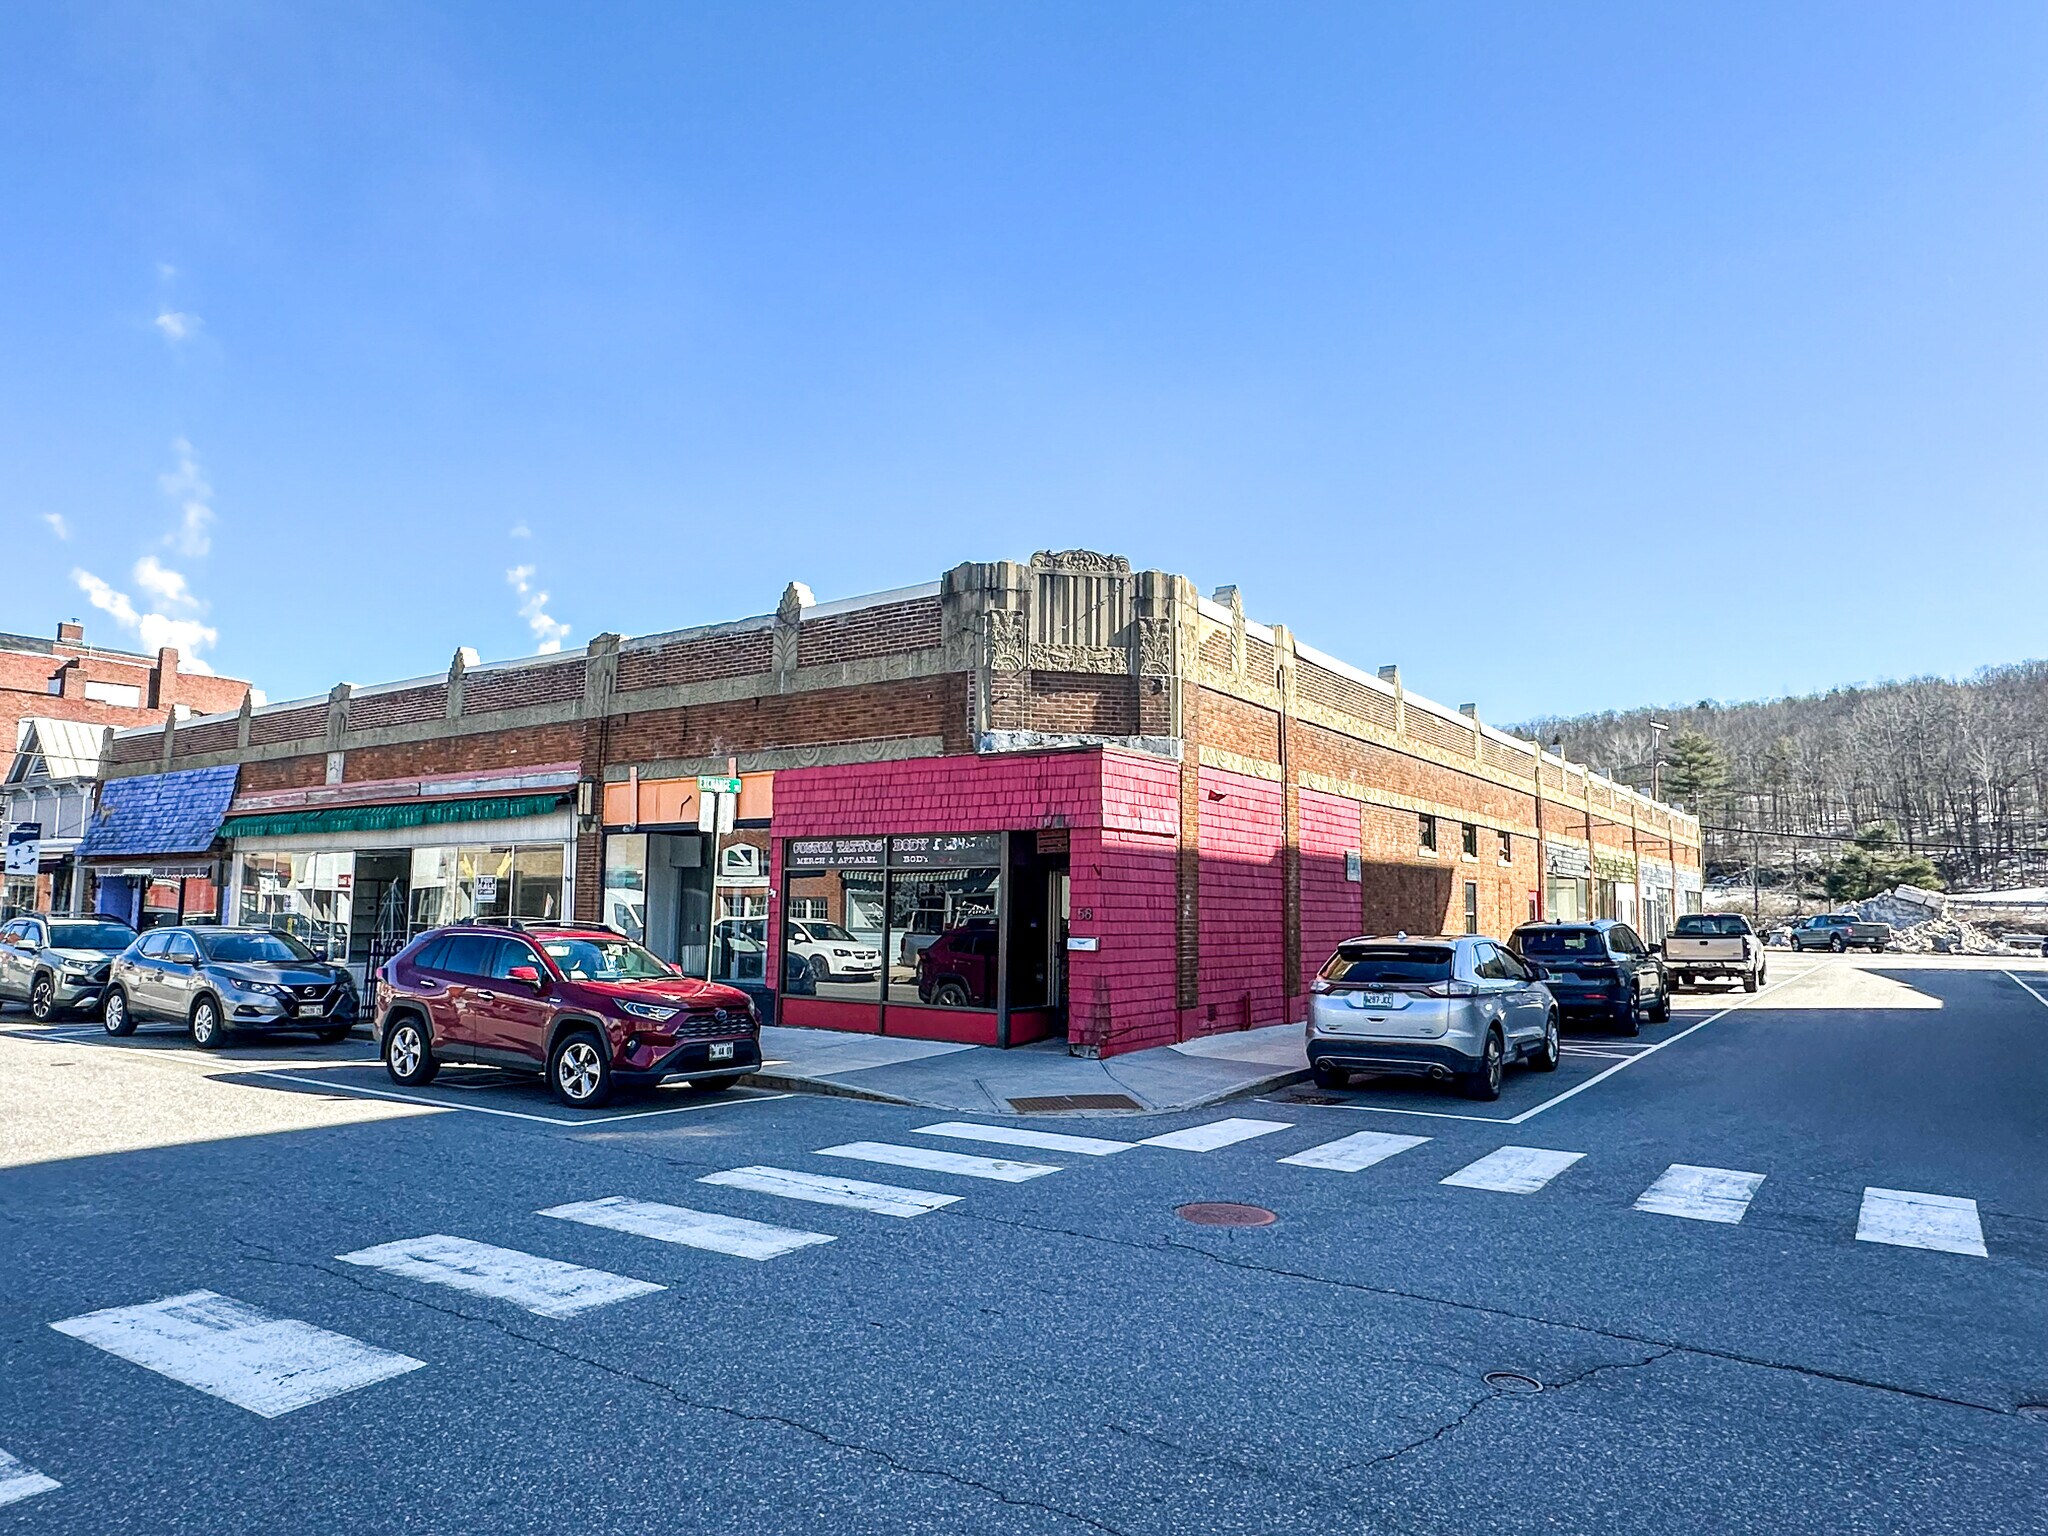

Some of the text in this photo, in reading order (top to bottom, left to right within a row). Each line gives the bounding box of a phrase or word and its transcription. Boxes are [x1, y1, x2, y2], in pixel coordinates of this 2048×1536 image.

[793, 841, 833, 853] CUSTOM
[892, 838, 929, 852] BODY
[796, 857, 826, 865] MERCH
[902, 855, 929, 863] BODY
[1077, 907, 1092, 920] 58
